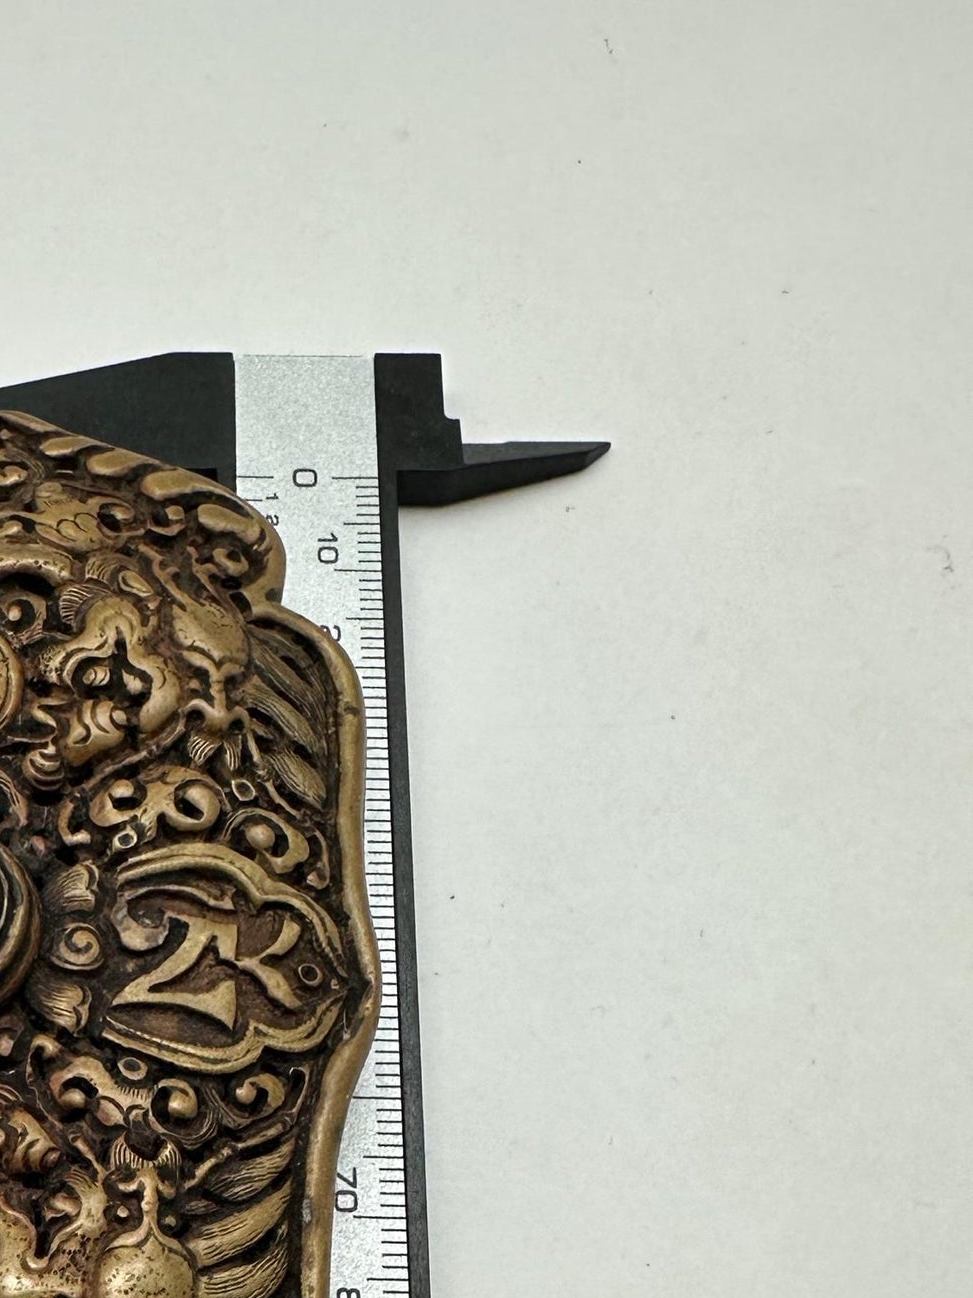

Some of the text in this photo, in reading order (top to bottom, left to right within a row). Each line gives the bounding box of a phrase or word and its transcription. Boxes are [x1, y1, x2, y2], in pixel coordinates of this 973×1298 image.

[265, 492, 279, 500] 1
[292, 468, 318, 488] 0
[317, 532, 340, 565] 10
[334, 1167, 359, 1213] 70
